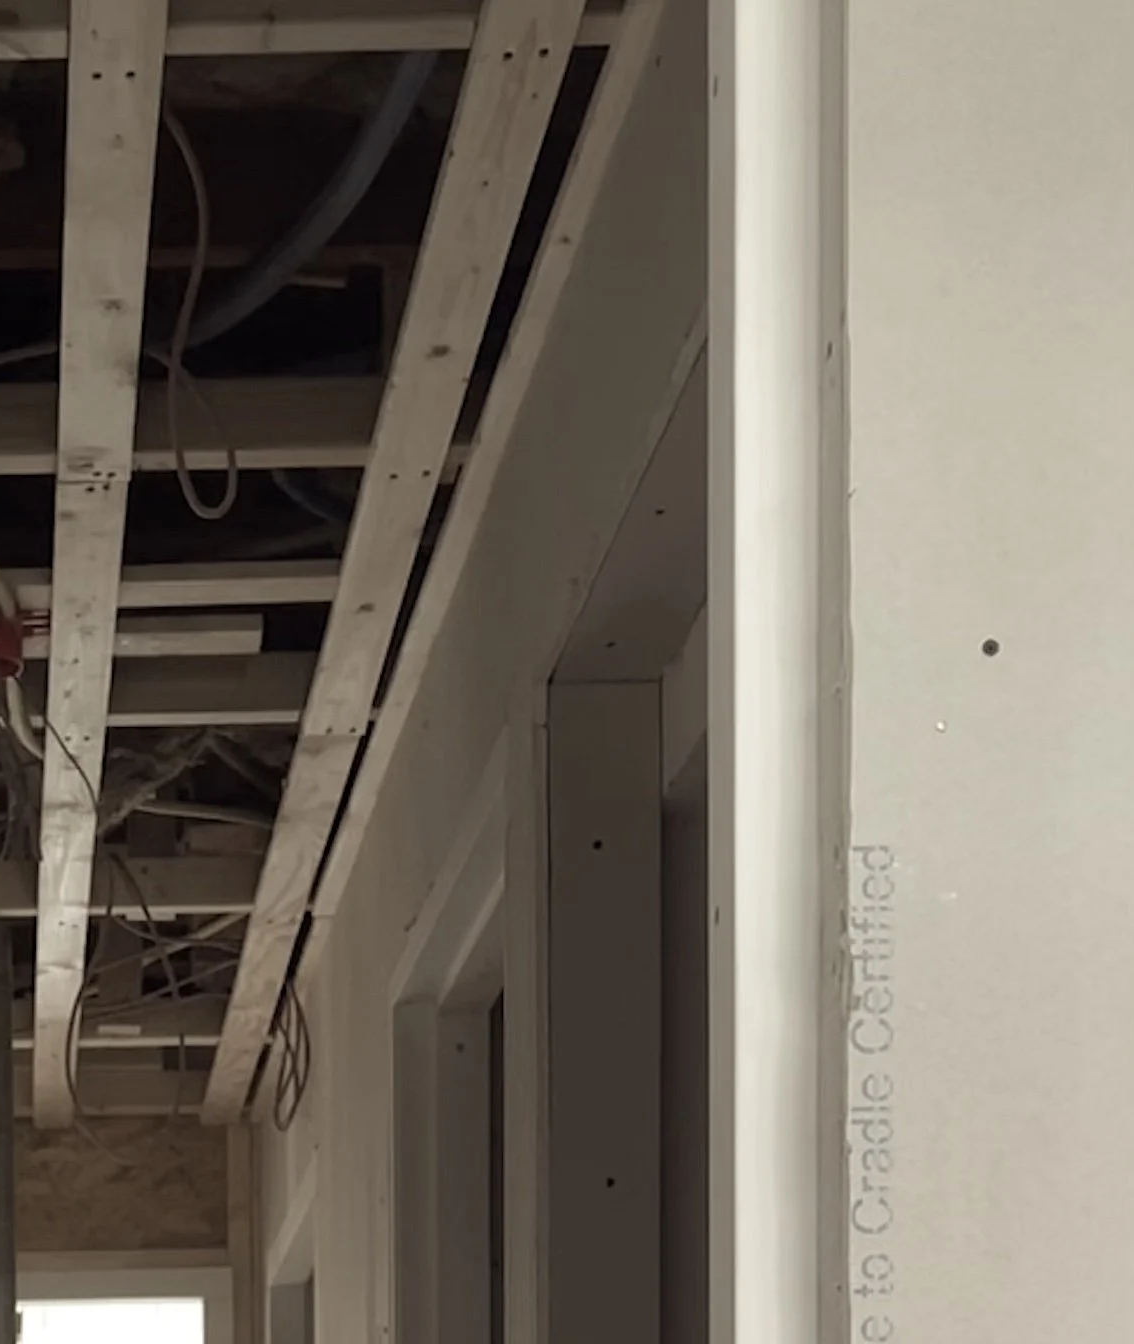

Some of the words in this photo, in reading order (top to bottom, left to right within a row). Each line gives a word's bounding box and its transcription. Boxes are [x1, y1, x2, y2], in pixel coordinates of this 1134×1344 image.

[851, 845, 896, 1055] Certified
[851, 1073, 894, 1235] Cradle
[854, 1252, 894, 1298] to
